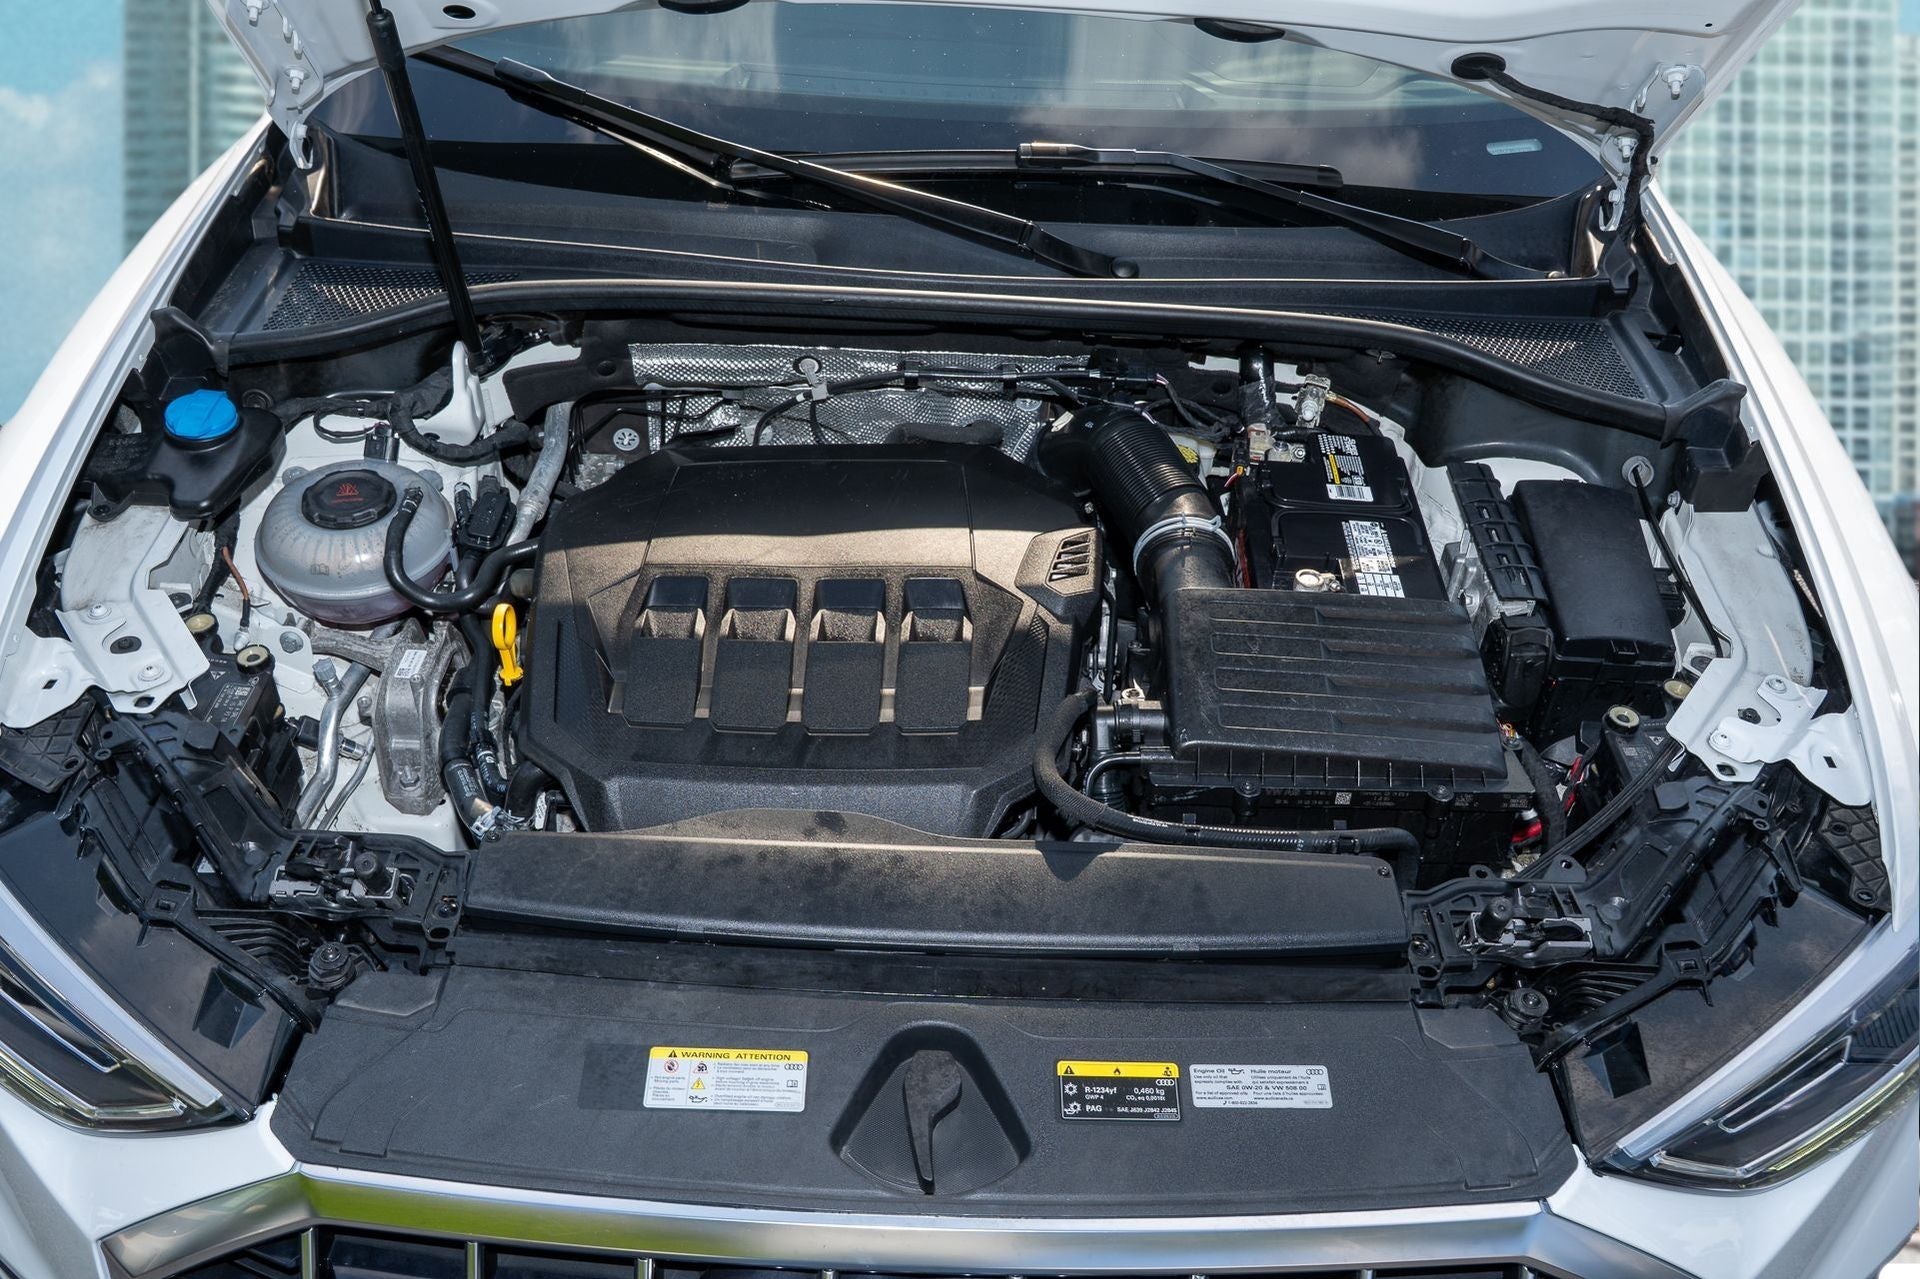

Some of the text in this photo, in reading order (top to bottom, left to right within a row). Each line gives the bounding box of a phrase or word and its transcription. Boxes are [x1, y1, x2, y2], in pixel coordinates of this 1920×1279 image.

[681, 1051, 791, 1061] WARNING ATTENTION
[1085, 1086, 1117, 1094] R-1234yf
